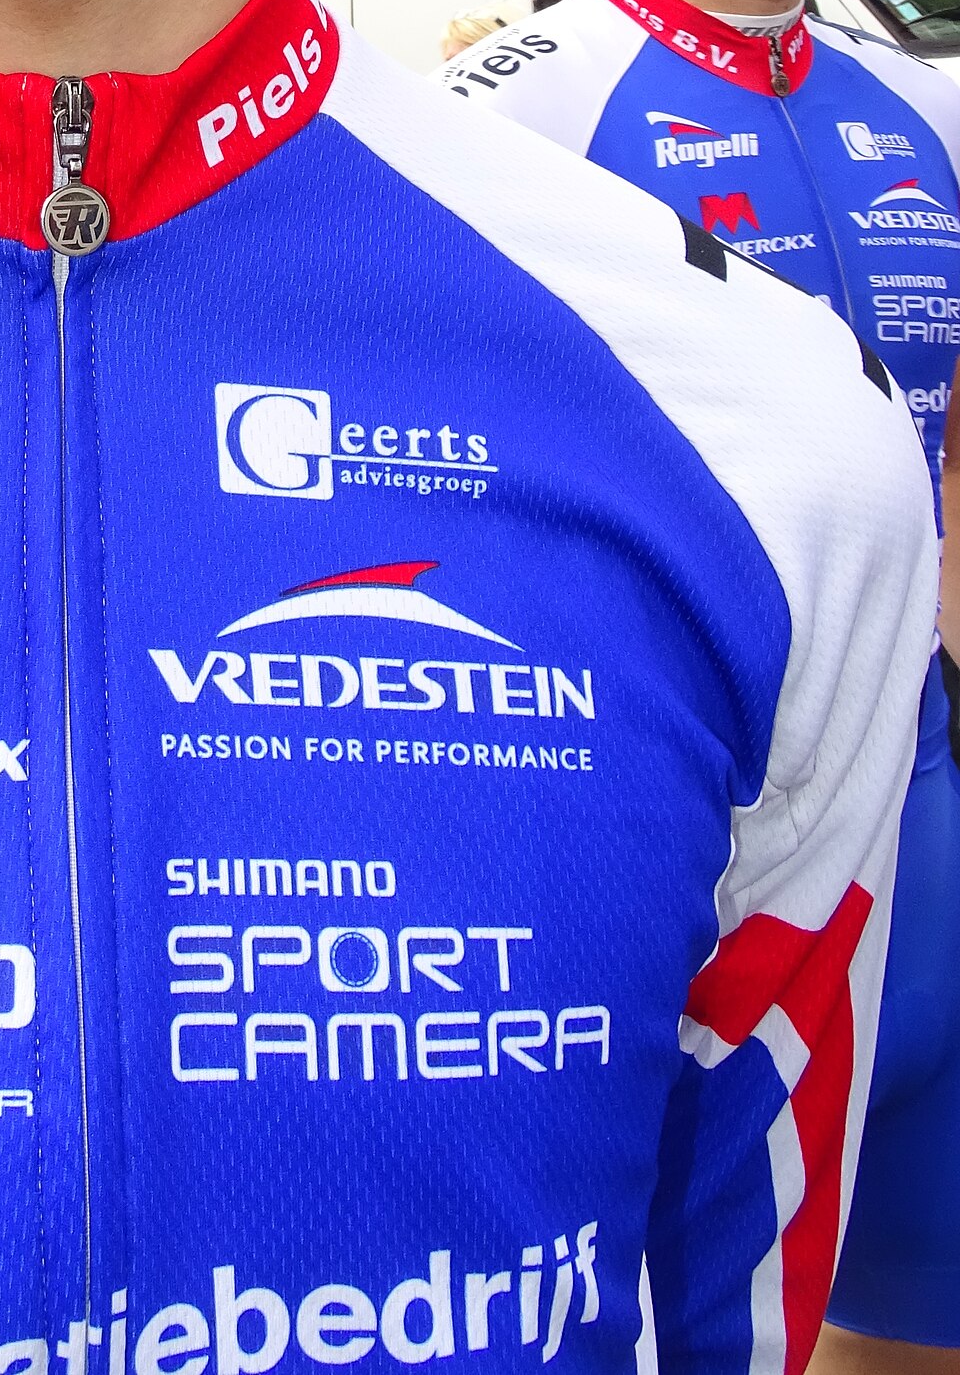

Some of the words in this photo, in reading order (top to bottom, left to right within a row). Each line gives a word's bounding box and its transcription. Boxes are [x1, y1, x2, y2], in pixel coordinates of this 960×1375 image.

[451, 34, 558, 97] iels
[672, 29, 738, 74] B.V.
[196, 28, 322, 169] Piels
[654, 133, 759, 169] Rogelli
[860, 236, 907, 247] PASSION
[869, 275, 947, 290] SHIMANO
[226, 393, 490, 491] Geerts
[340, 465, 488, 498] adviesgroep
[147, 647, 596, 720] VREDESTEIN
[161, 733, 292, 761] PASSION
[305, 737, 365, 763] FOR
[376, 739, 594, 771] PERFORMANCE
[166, 858, 396, 898] SHIMANO
[167, 925, 533, 994] SPORT
[170, 1005, 611, 1082] CAMERA
